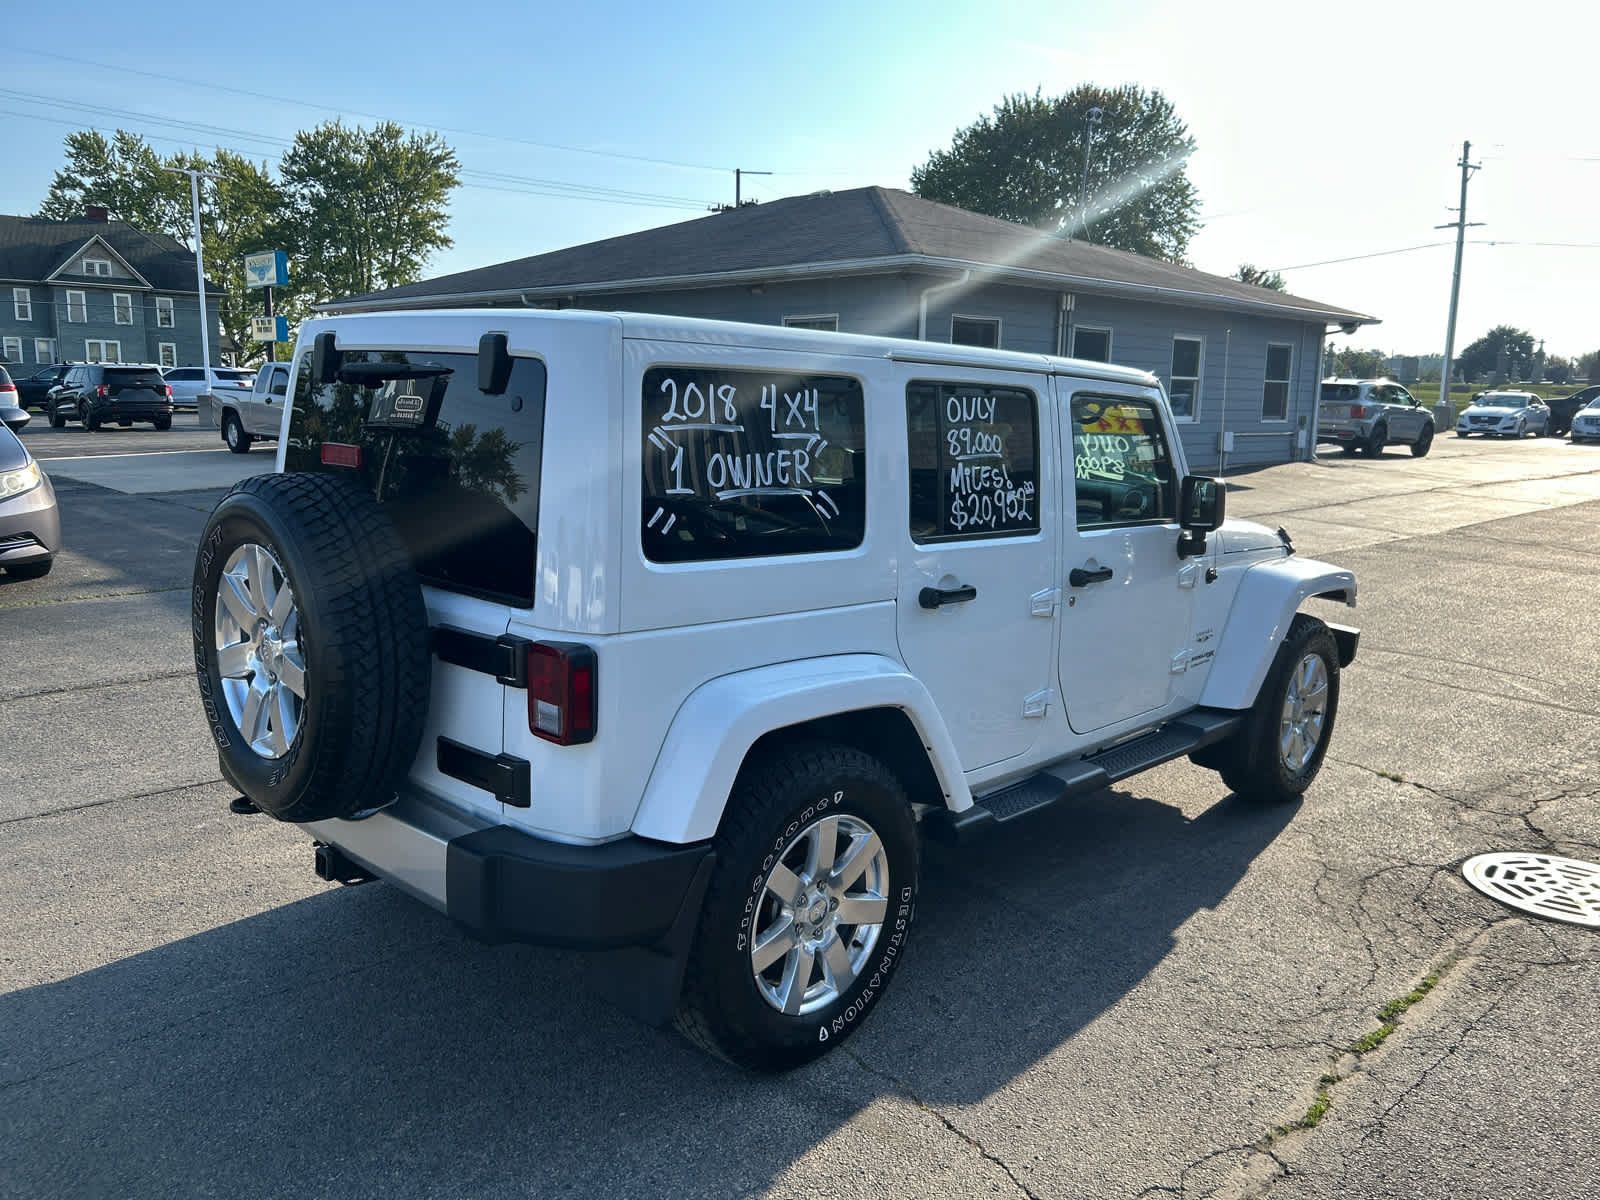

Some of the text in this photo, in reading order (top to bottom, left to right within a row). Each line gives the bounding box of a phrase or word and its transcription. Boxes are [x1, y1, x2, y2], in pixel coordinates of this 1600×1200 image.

[661, 378, 737, 424] 2018
[946, 396, 996, 424] ONLY
[947, 428, 1002, 456] 89,000
[665, 446, 813, 495] 1 OWNER
[192, 584, 231, 750] DUELER
[831, 887, 912, 1035] DESTINATION
